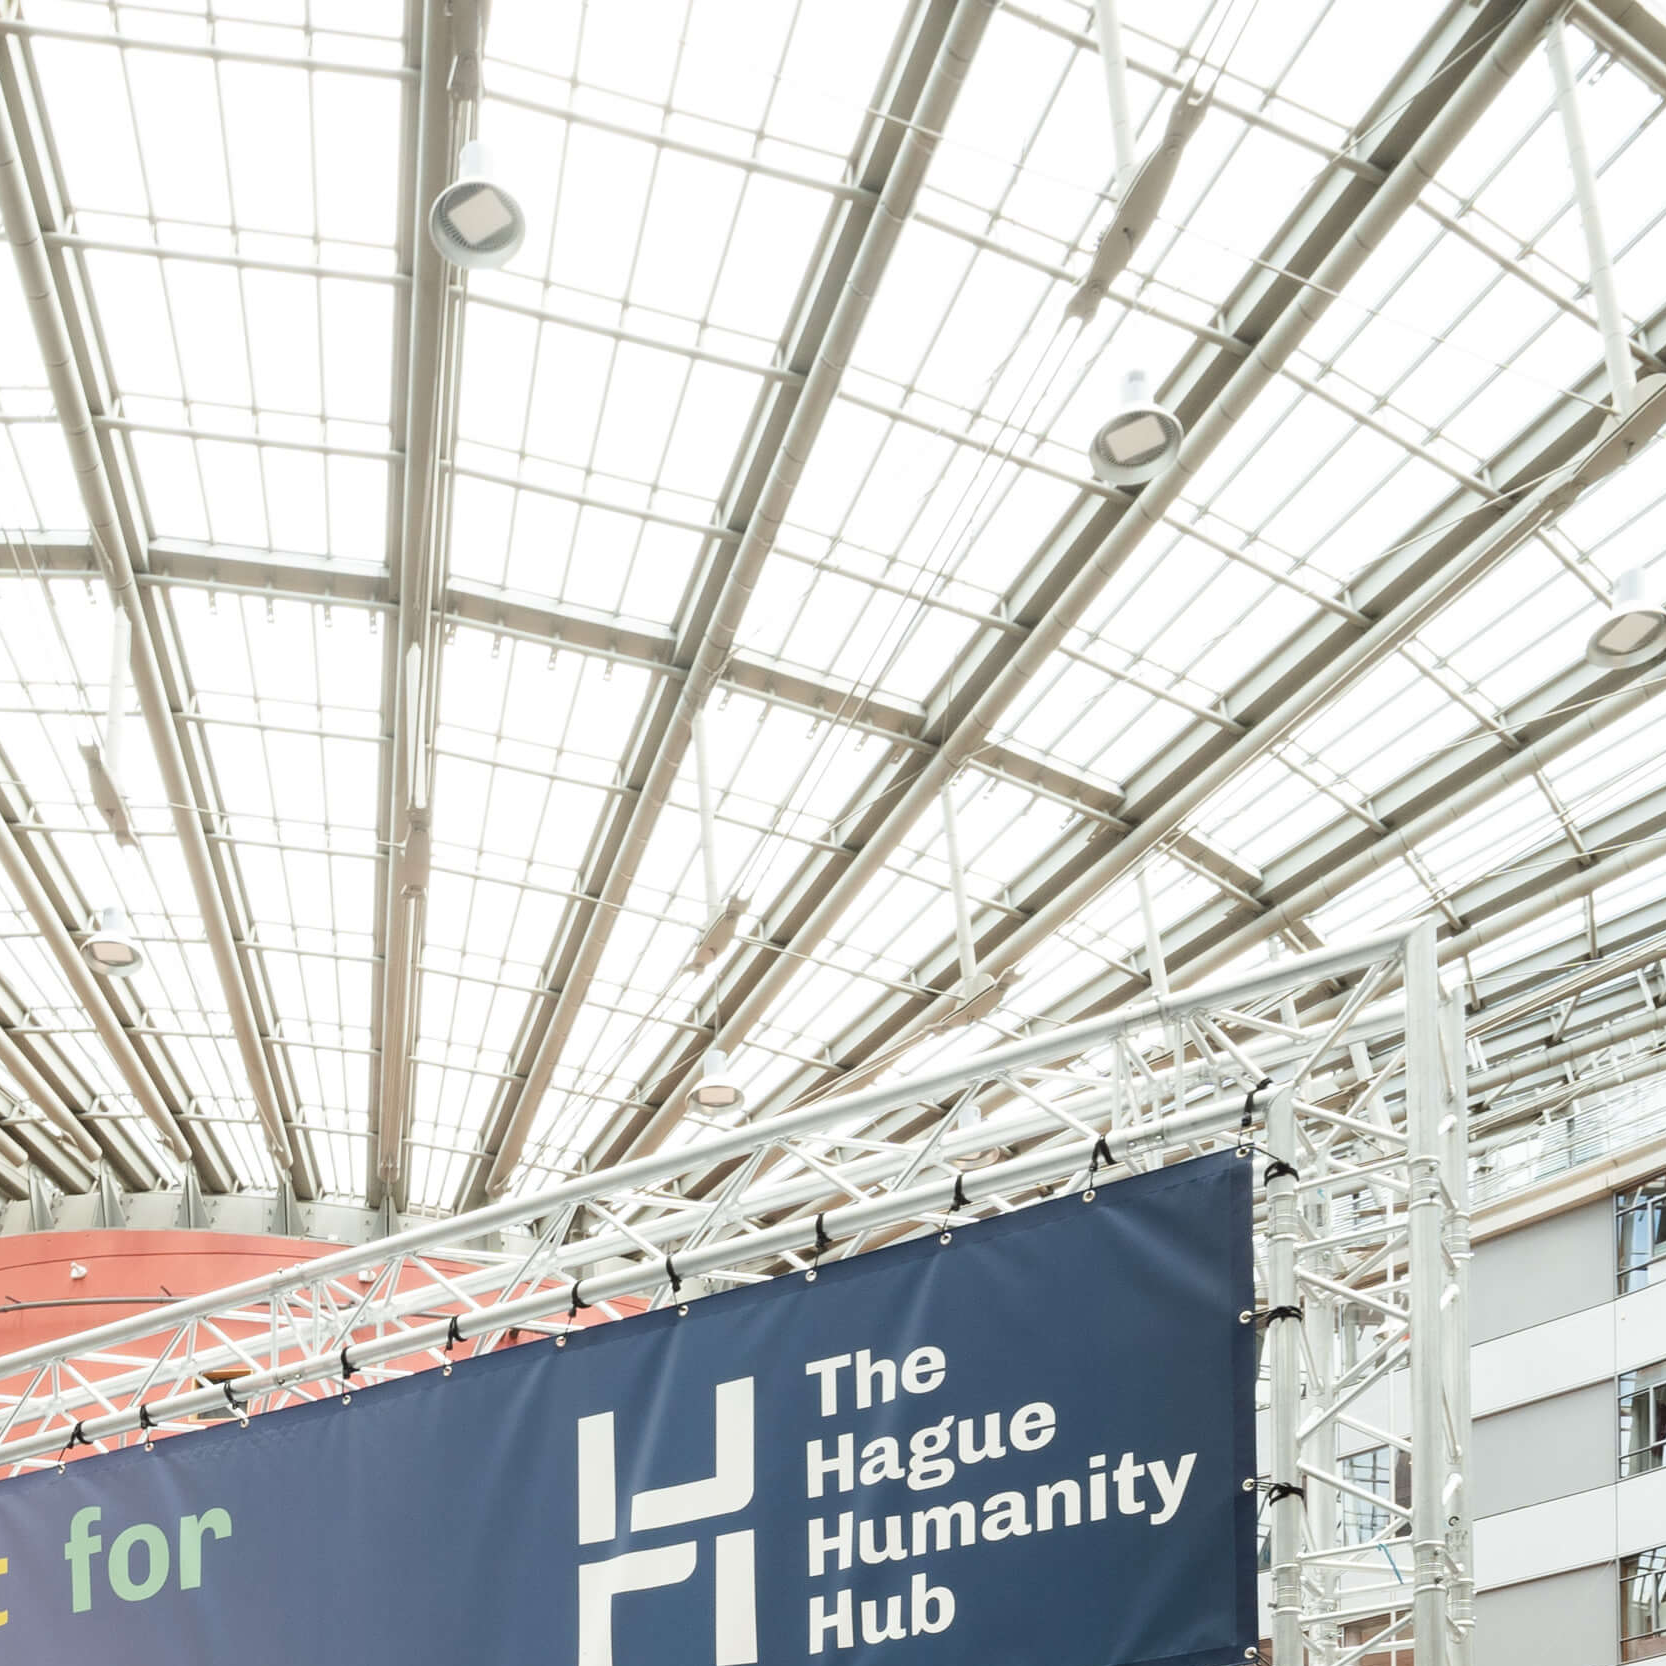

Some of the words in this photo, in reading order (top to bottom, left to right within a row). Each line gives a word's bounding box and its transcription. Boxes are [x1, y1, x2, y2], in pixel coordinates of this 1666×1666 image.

[806, 1345, 947, 1417] The
[806, 1401, 1056, 1498] Hague
[64, 1506, 233, 1614] for
[808, 1452, 1197, 1577] Humanity
[809, 1575, 956, 1655] Hub
